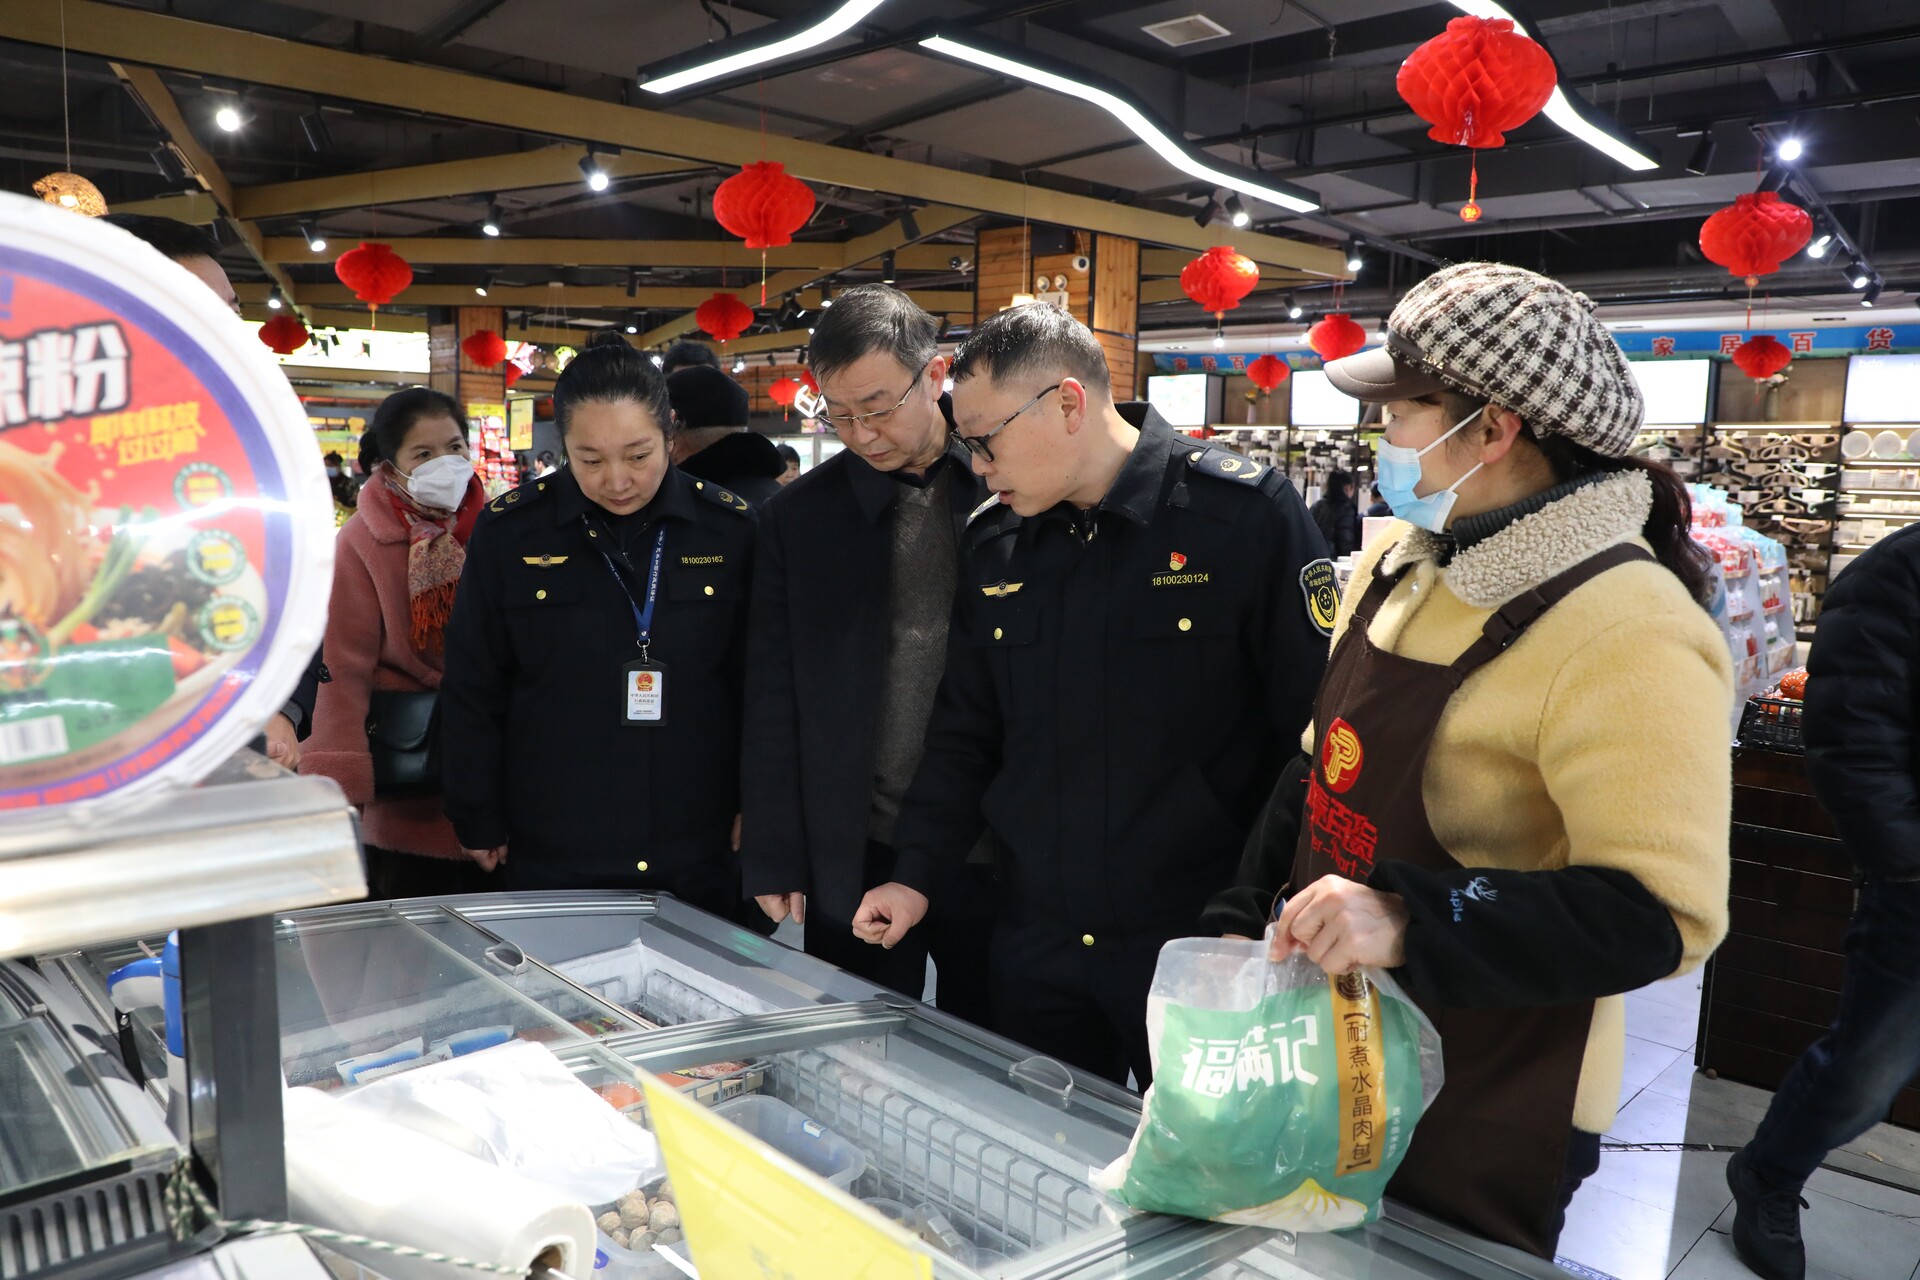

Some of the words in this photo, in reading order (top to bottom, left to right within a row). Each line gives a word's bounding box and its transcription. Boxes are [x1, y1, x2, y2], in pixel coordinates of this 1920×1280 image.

[1652, 328, 1895, 357] 家居百货
[1173, 354, 1246, 372] 家居百
[1152, 573, 1209, 586] 18100230124
[1181, 1015, 1319, 1099] 福满记
